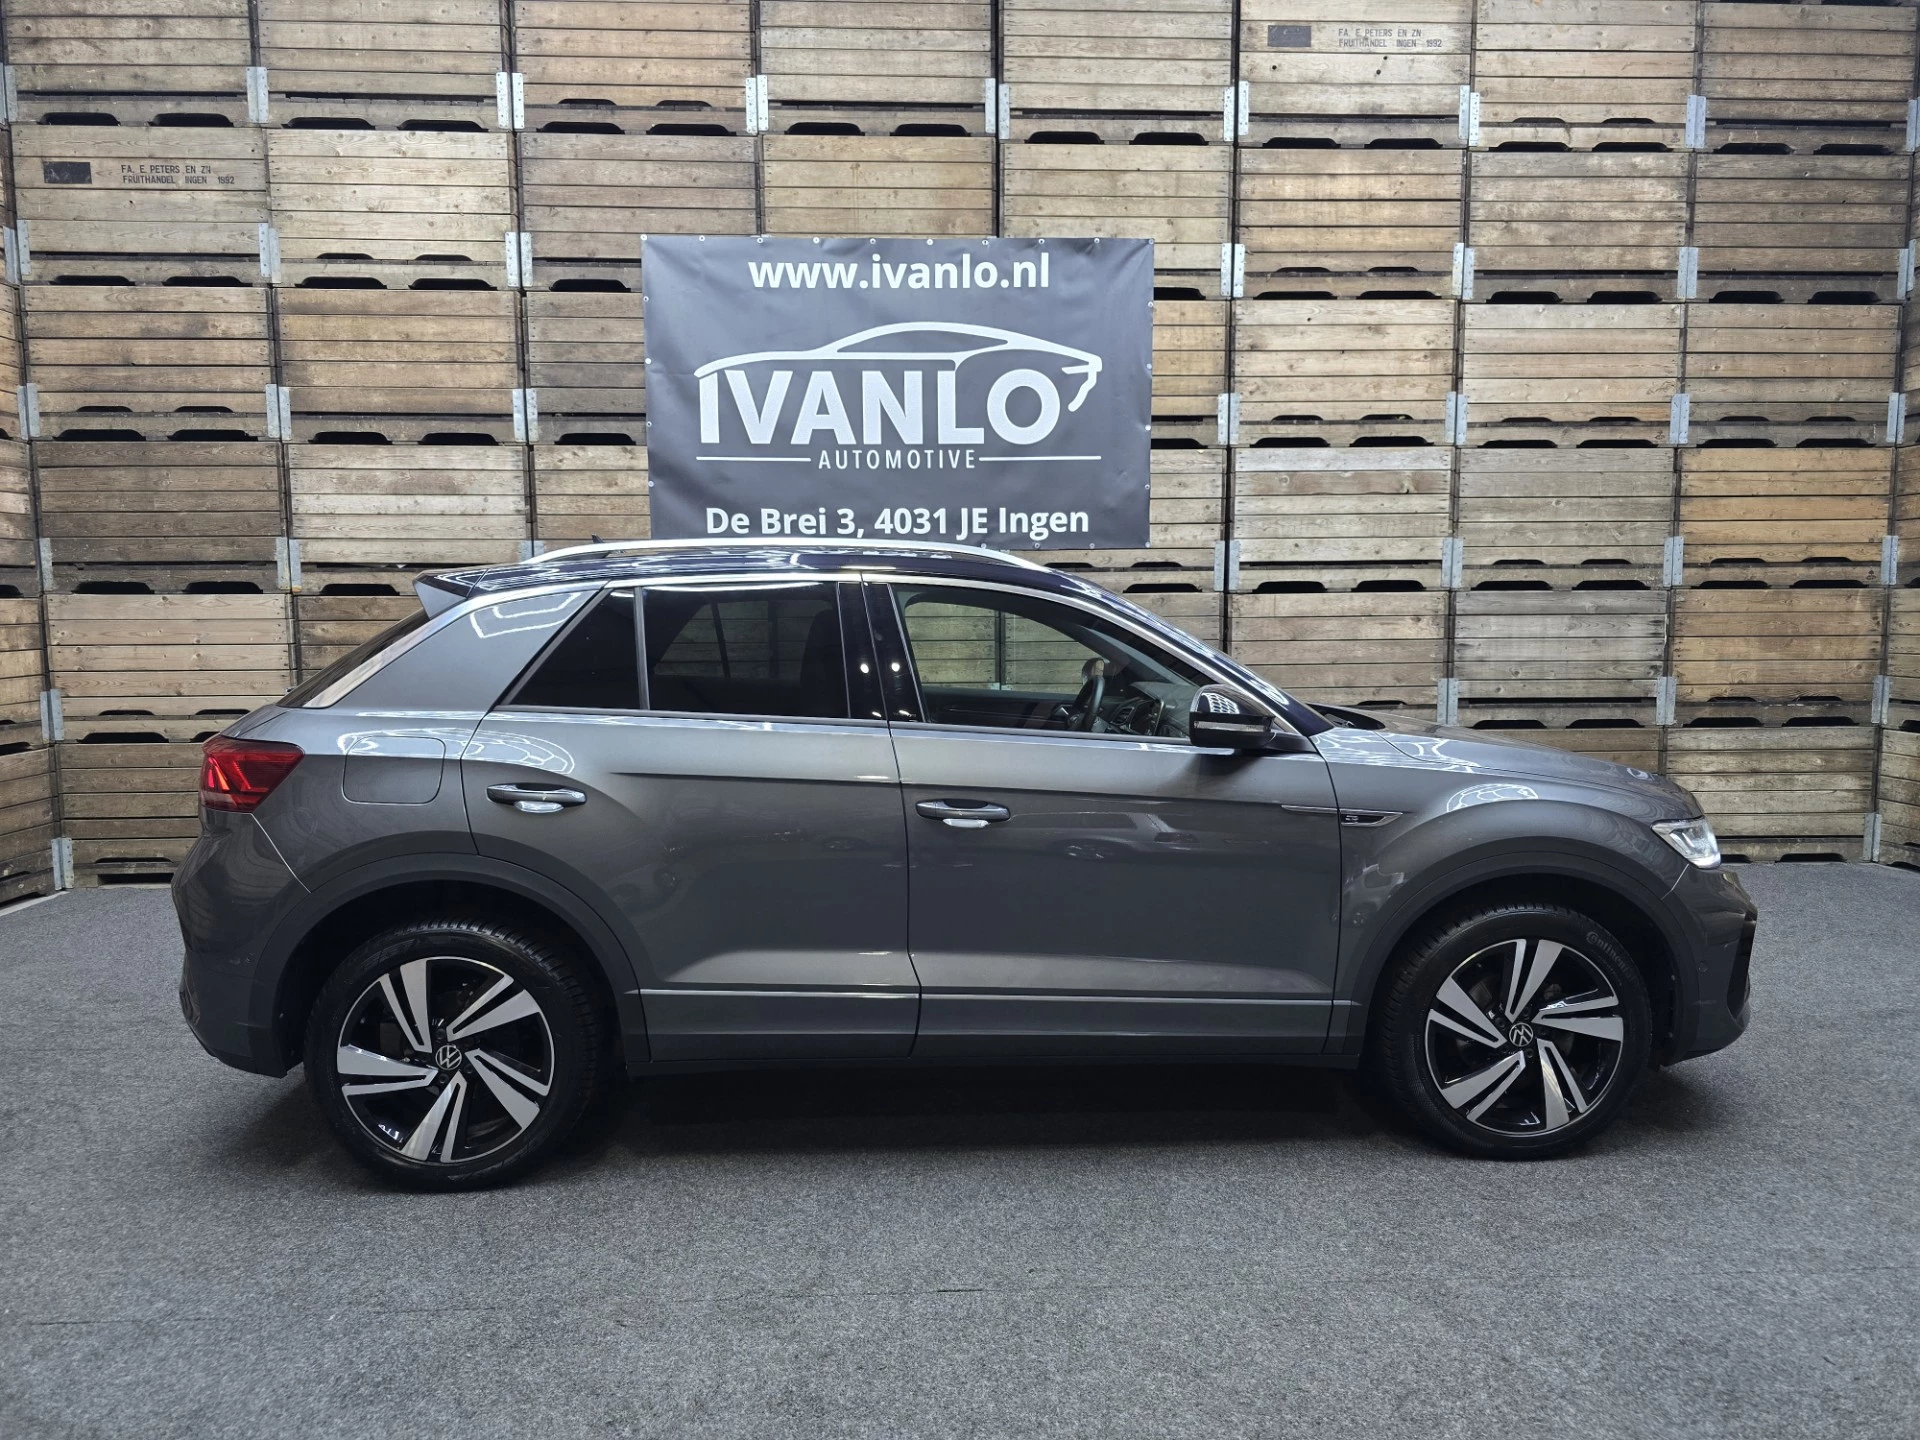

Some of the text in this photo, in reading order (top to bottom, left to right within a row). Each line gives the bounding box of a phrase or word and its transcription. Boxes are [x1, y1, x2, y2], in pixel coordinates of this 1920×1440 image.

[1364, 28, 1393, 37] PETERS
[1397, 28, 1407, 37] EN
[1338, 38, 1388, 47] FRUITHANDEL
[1396, 38, 1417, 47] INGEN
[150, 165, 180, 174] PETERS
[185, 165, 196, 174] EN
[122, 175, 176, 184] FRUITHANDEL
[184, 176, 207, 184] INGEN
[747, 252, 1050, 289] www.ivanlo.nl
[699, 368, 1061, 446] IVANLO
[818, 449, 975, 470] AUTOMOTIVE
[706, 507, 1089, 541] De Brei 3, 4031 JE Ingen
